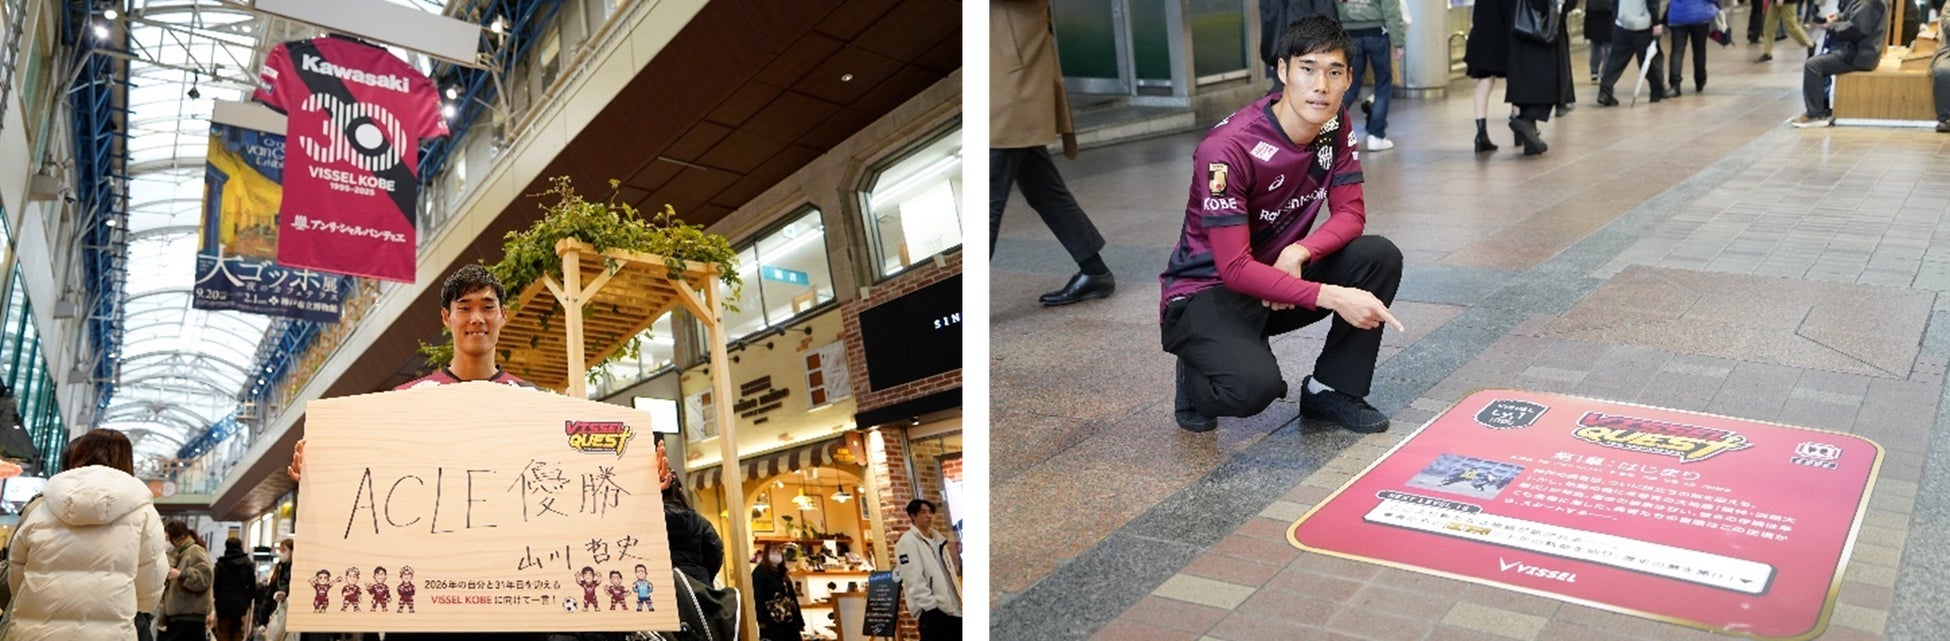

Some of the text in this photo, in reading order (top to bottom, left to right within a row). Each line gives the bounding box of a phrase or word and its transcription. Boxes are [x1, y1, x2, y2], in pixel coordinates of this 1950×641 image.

[303, 54, 410, 93] Kawasaki
[300, 93, 407, 172] 30
[308, 165, 396, 192] VISSEL KOBE
[330, 182, 375, 196] 1995-2025
[1203, 197, 1238, 212] KOBE
[195, 243, 339, 294] 大ゴッホ展
[565, 420, 624, 435] VISSEL
[569, 426, 633, 456] QUEST
[1577, 427, 1740, 460] QUEST
[1517, 563, 1577, 583] VISSEL
[431, 595, 462, 605] VISSEL
[465, 595, 492, 605] KOBE
